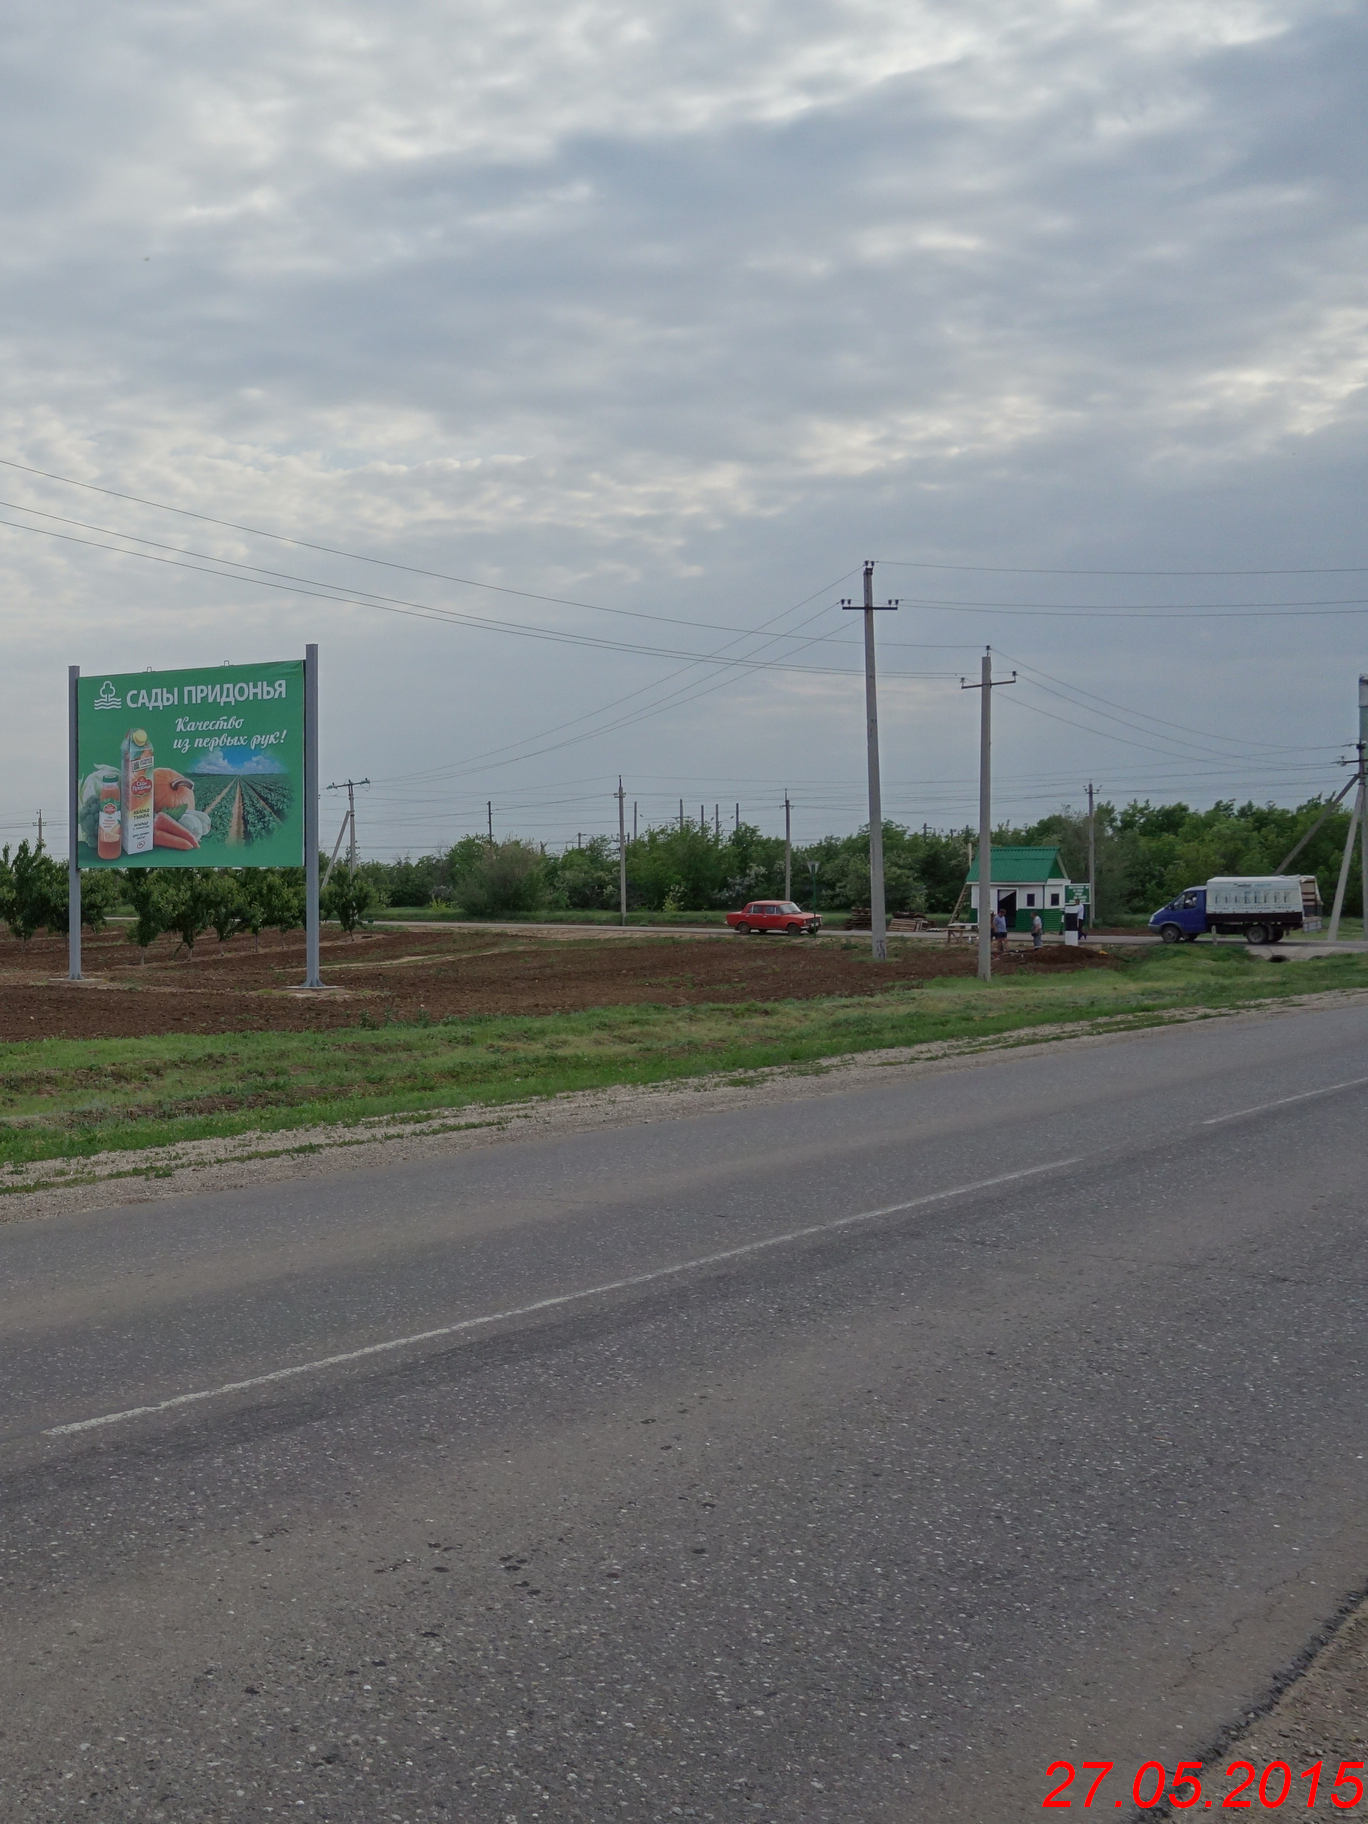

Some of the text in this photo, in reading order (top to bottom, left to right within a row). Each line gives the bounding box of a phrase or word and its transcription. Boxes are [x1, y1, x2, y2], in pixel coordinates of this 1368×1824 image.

[126, 680, 286, 711] САДЫ ПРИДОНЬЯ
[175, 716, 244, 733] Качество
[173, 730, 287, 753] из первых рук!
